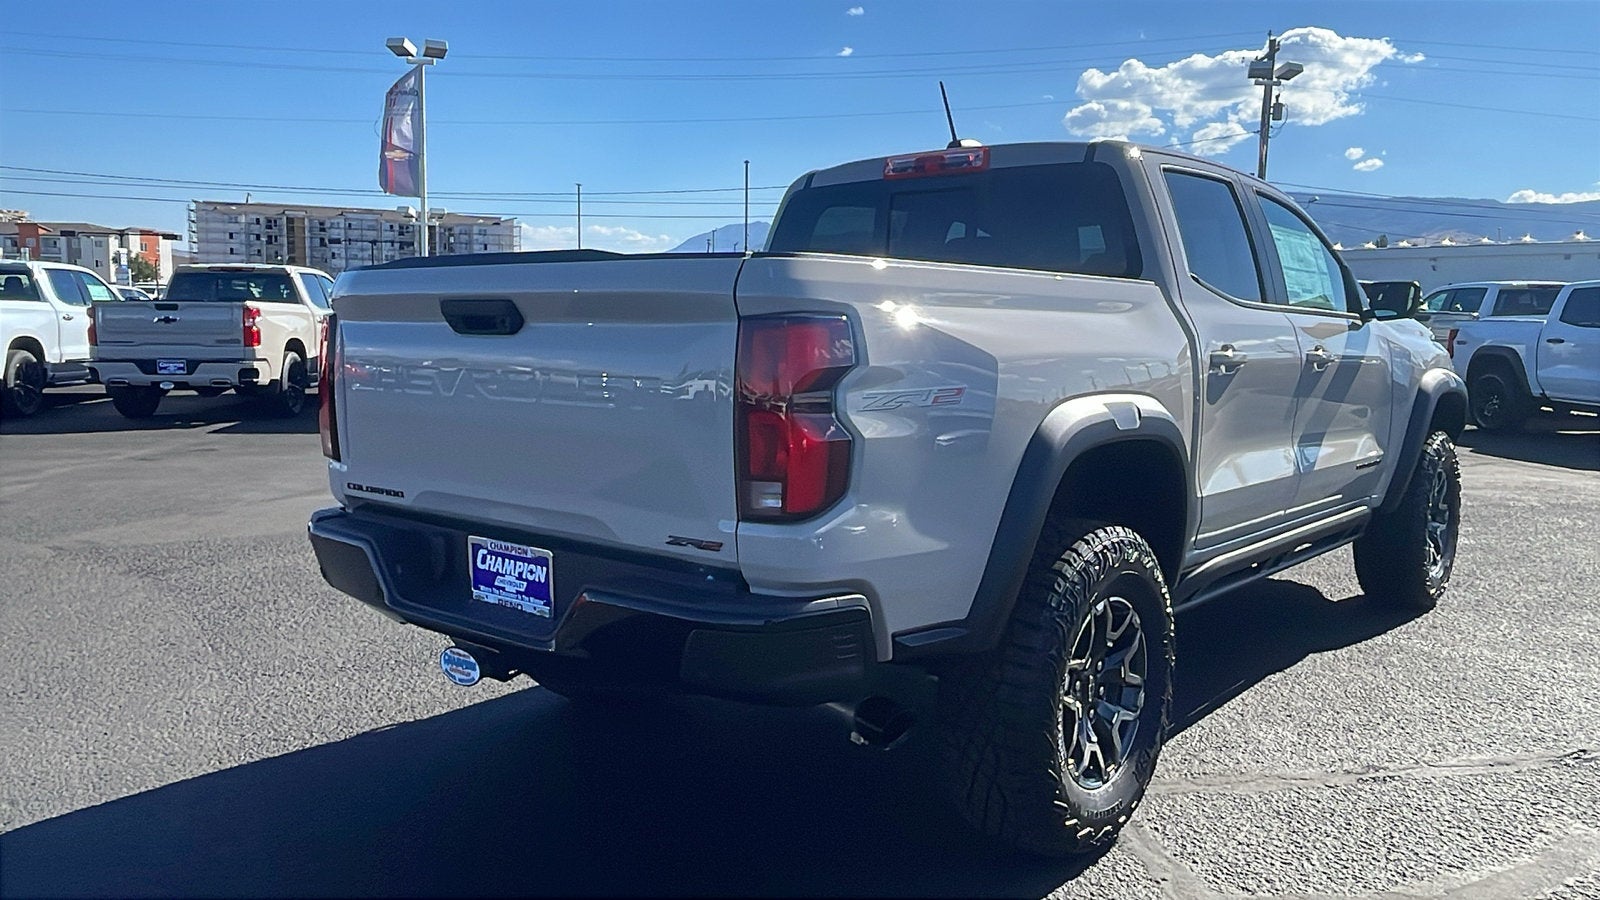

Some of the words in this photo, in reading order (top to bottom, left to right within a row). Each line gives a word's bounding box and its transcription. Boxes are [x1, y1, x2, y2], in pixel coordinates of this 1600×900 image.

[857, 386, 967, 412] ZR2
[347, 482, 404, 498] COLORADO
[489, 541, 528, 554] CHAMPION
[665, 535, 723, 552] ZR2
[477, 548, 547, 583] CHAMPION
